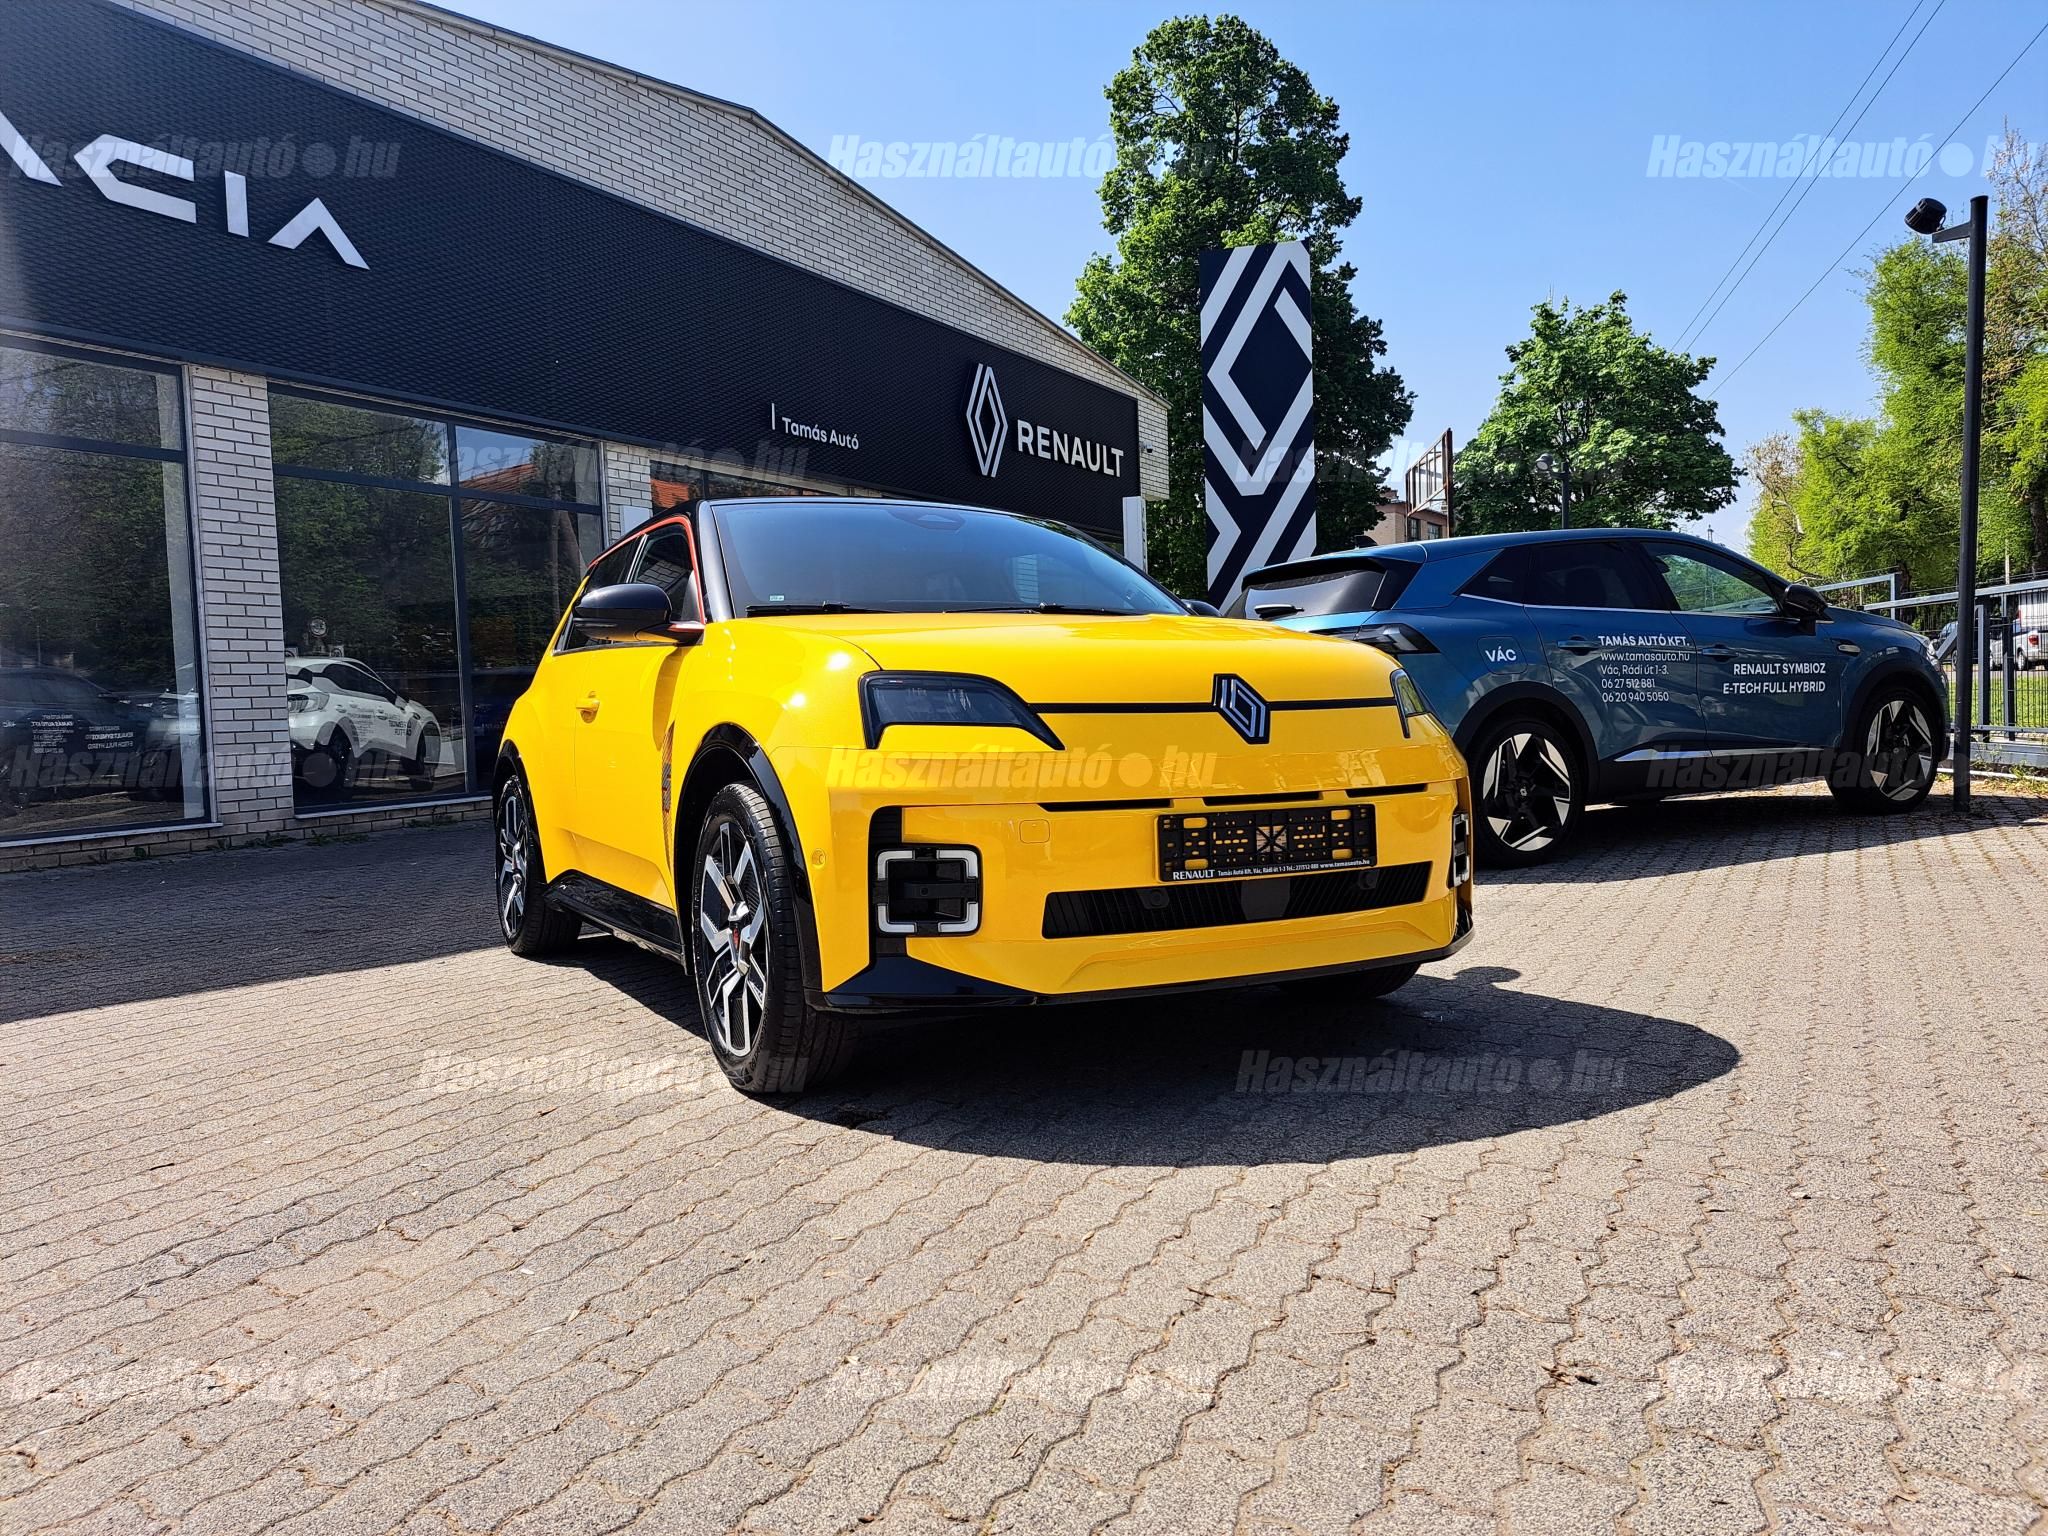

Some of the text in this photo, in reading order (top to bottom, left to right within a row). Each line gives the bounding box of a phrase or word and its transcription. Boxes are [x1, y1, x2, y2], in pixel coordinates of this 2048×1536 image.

[782, 416, 860, 450] Tamás Autó
[1017, 419, 1124, 478] RENAULT
[1597, 633, 1690, 646] TAMÁS AUTÓ KFT.
[1485, 645, 1517, 662] VÁC
[1600, 651, 1690, 661] www.tamasauto.hu
[1600, 664, 1670, 676] Vác, Rádi út 1-3.
[1733, 662, 1826, 675] RENAULT SYMBIOZ
[1601, 678, 1655, 689] 06 27 512 881
[1723, 681, 1826, 694] E-TECH FULL HYBRID
[1602, 691, 1669, 703] 06 20 940 5050
[1173, 869, 1215, 880] RENAULT
